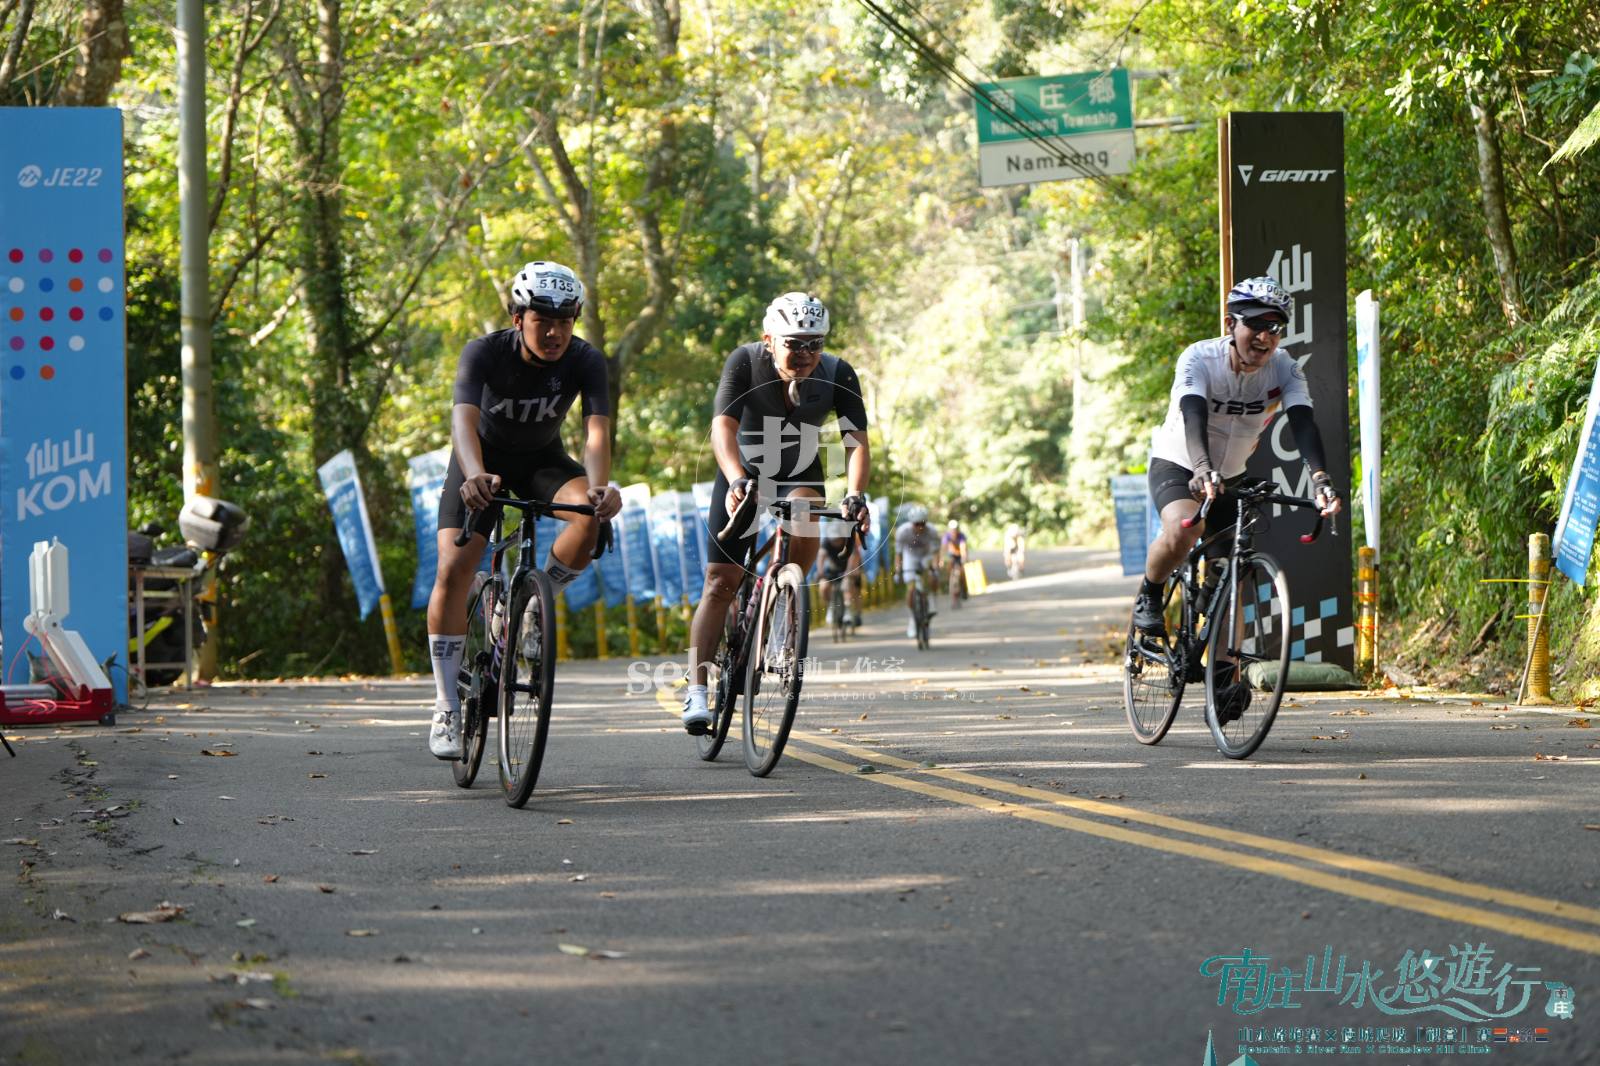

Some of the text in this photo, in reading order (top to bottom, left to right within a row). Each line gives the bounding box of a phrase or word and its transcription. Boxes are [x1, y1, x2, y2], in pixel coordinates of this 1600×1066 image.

[1062, 109, 1118, 128] Township
[43, 167, 102, 187] JE22
[1259, 169, 1337, 183] GIANT
[489, 395, 561, 422] ATK
[25, 429, 94, 480] 仙山
[17, 461, 111, 522] KOM
[432, 641, 462, 657] EF
